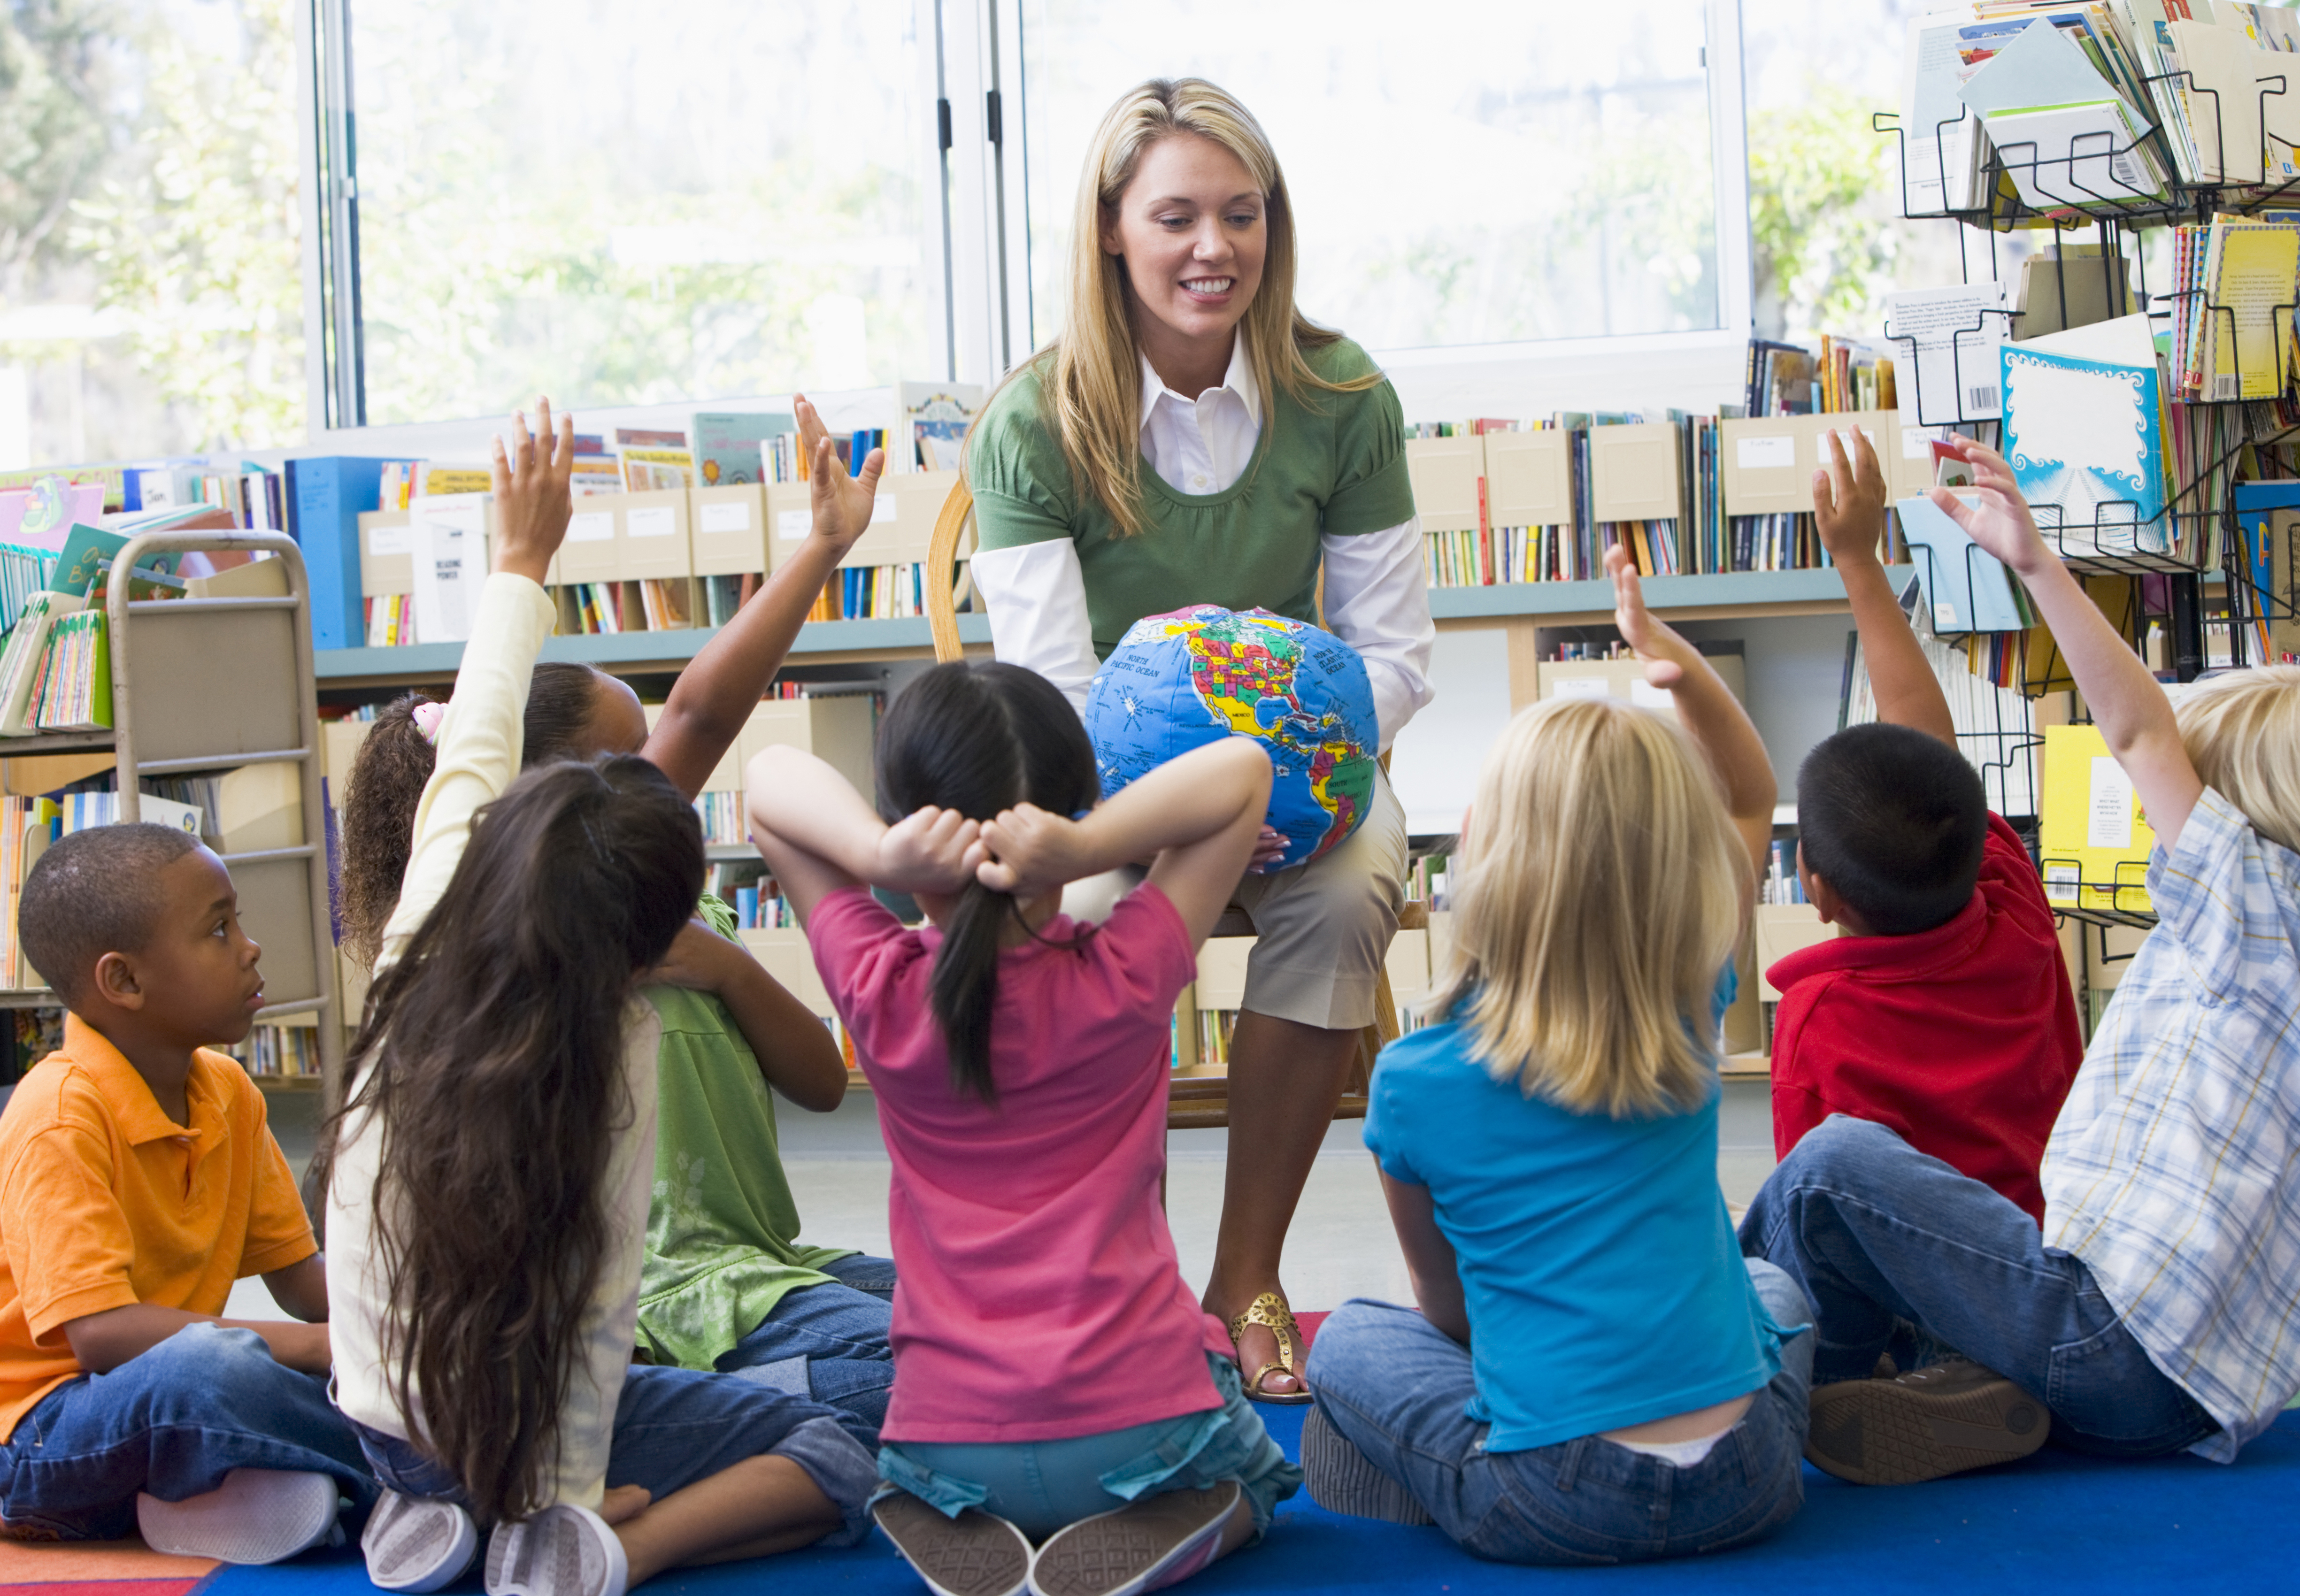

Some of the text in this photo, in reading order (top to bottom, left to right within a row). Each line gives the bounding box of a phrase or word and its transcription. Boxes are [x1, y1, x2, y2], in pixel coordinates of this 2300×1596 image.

[1126, 654, 1149, 665] NORTH
[1318, 653, 1344, 669] ATLANTIC
[1110, 660, 1160, 677] PACIFIC OCEAN
[1326, 661, 1346, 675] OCEAN
[1329, 780, 1347, 788] SOUTH
